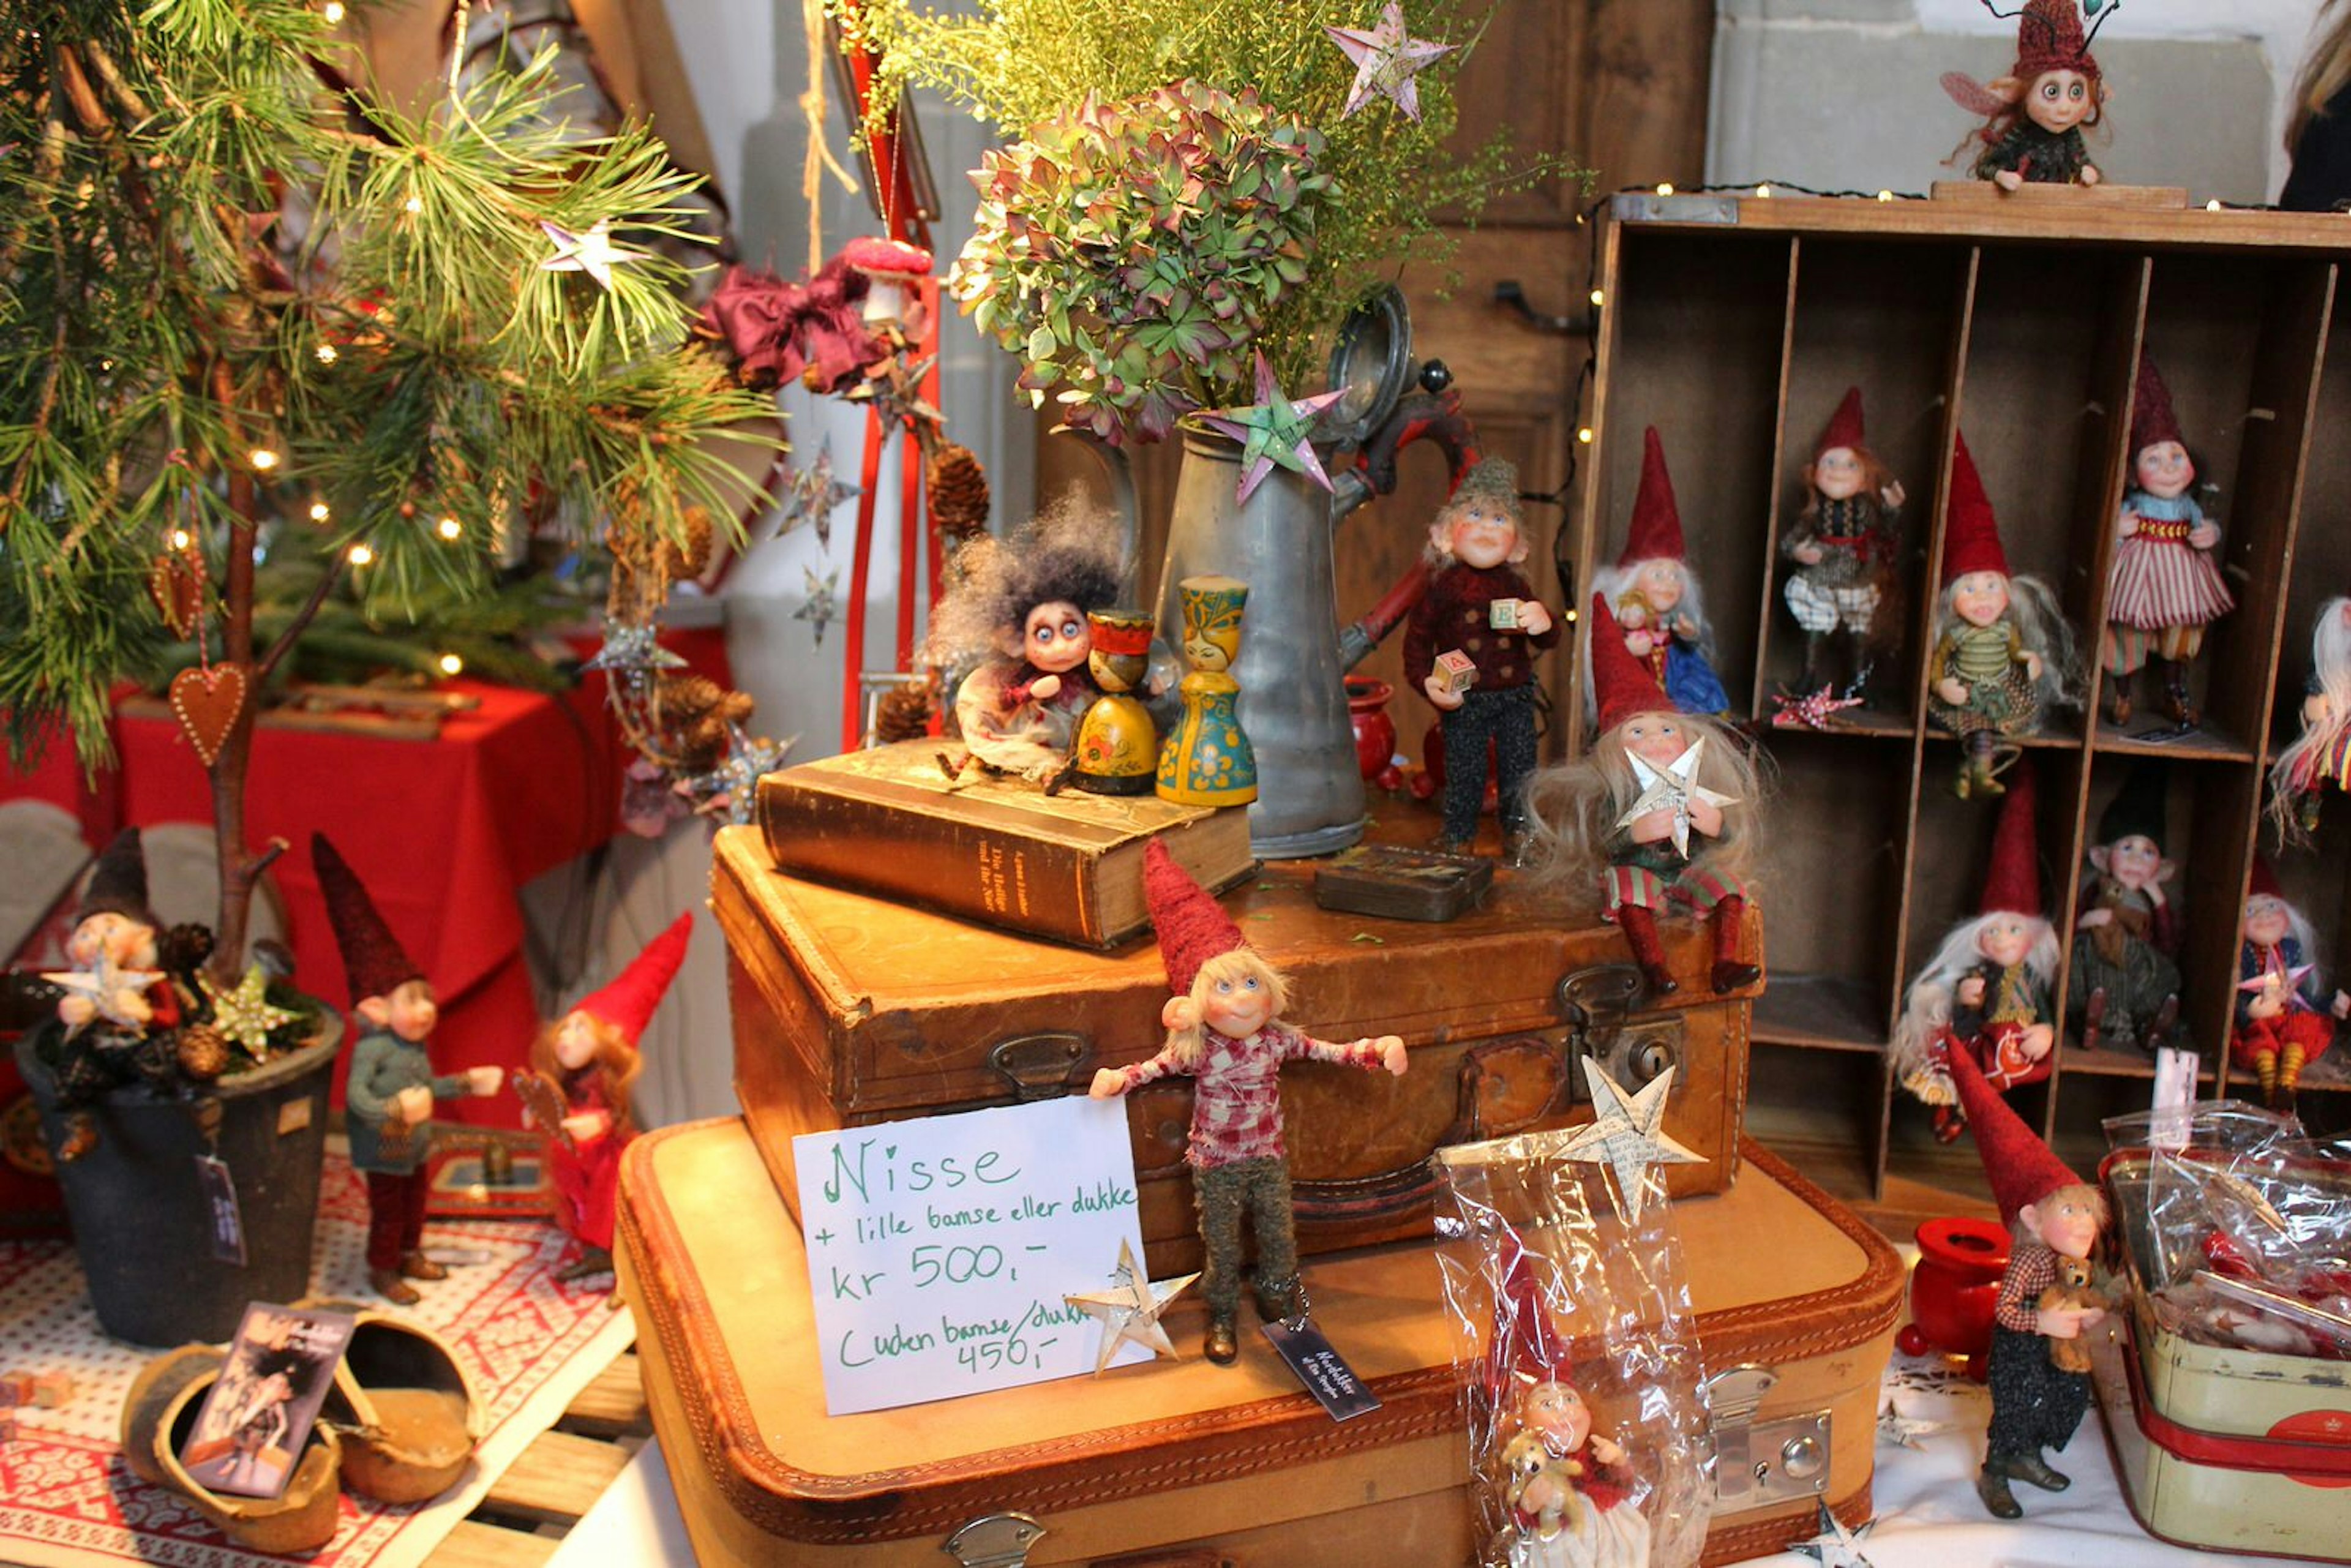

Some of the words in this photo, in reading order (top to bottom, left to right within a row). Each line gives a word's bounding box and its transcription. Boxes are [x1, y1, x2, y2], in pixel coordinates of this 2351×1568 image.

[823, 1138, 1021, 1203] Nisse
[815, 1228, 835, 1245] +
[857, 1212, 913, 1244] lille
[928, 1206, 1002, 1229] bamse
[1010, 1196, 1062, 1220] eller
[1071, 1177, 1139, 1214] dukke
[831, 1266, 886, 1300] kr
[911, 1244, 1048, 1288] 500,-
[958, 1337, 1058, 1374] 450,-
